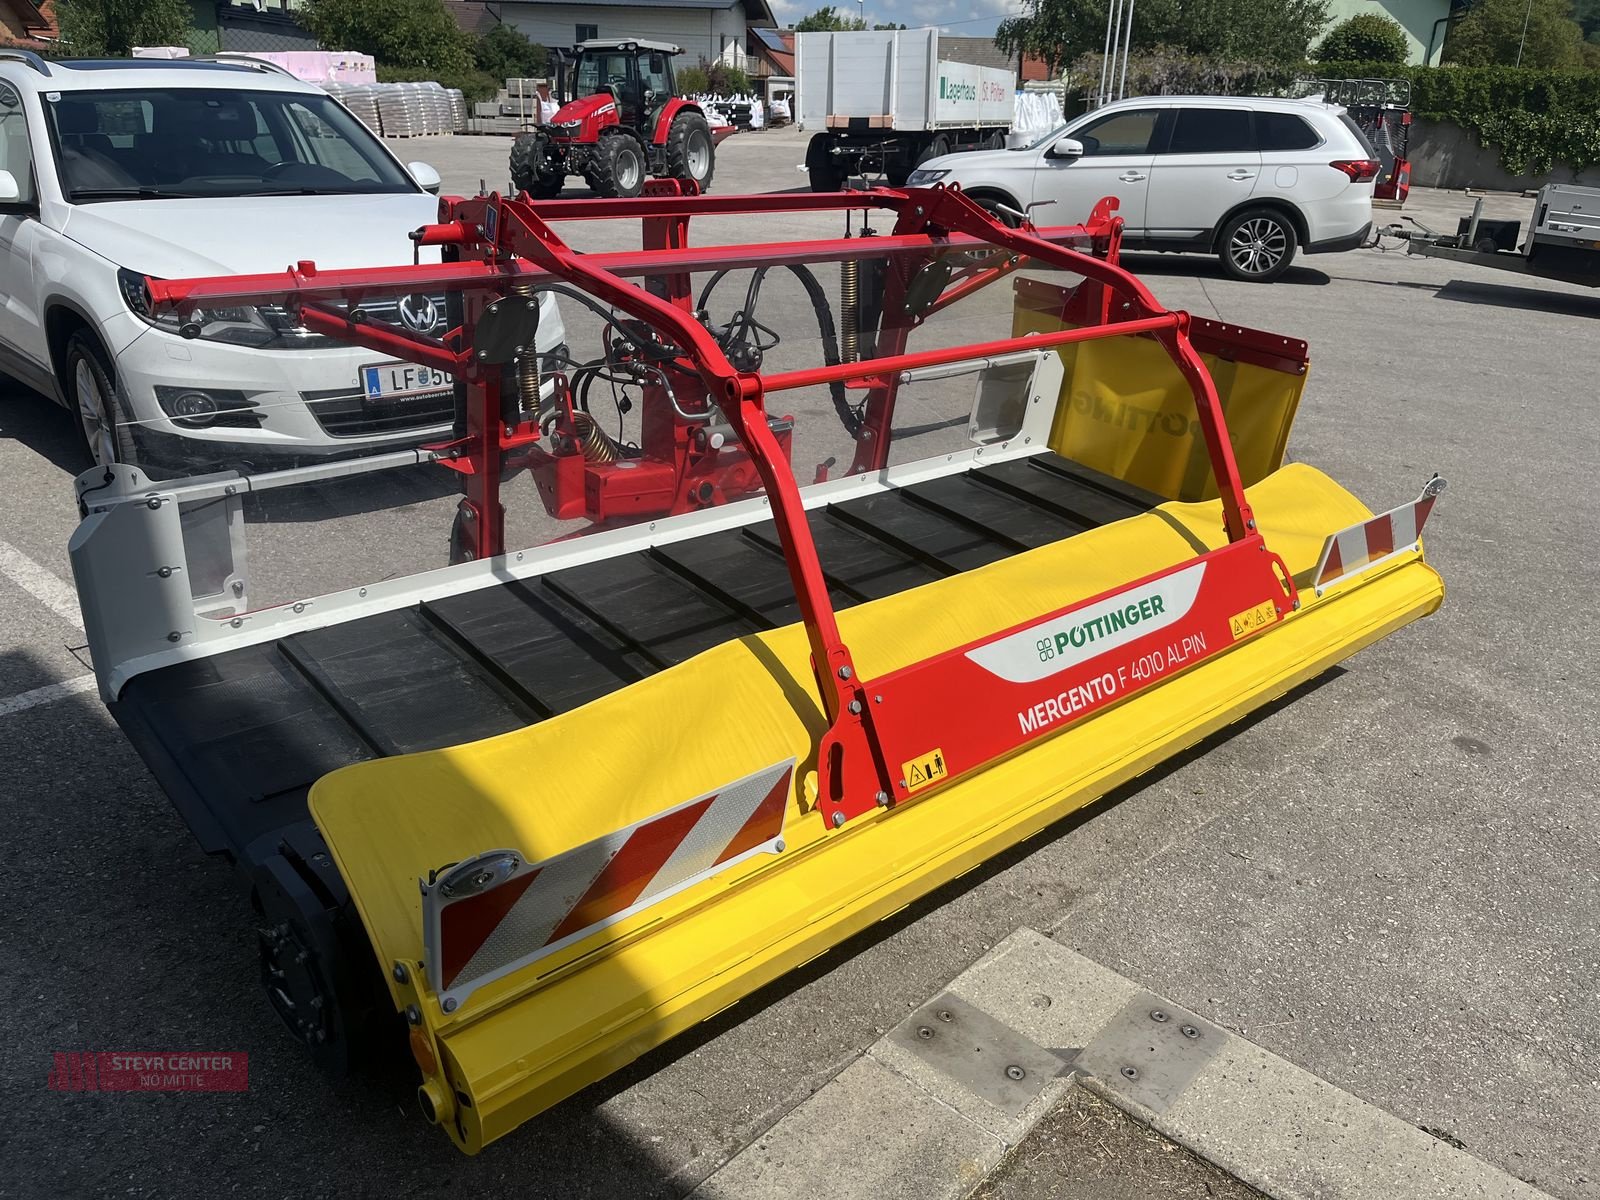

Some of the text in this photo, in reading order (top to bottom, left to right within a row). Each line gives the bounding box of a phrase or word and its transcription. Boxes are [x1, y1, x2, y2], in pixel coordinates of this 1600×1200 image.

[946, 77, 976, 104] Lagerhaus
[371, 386, 378, 394] A
[391, 368, 414, 390] LF
[1053, 594, 1166, 655] PÖTTINGER
[1018, 631, 1207, 734] MERGENTO F 4010 ALPIN
